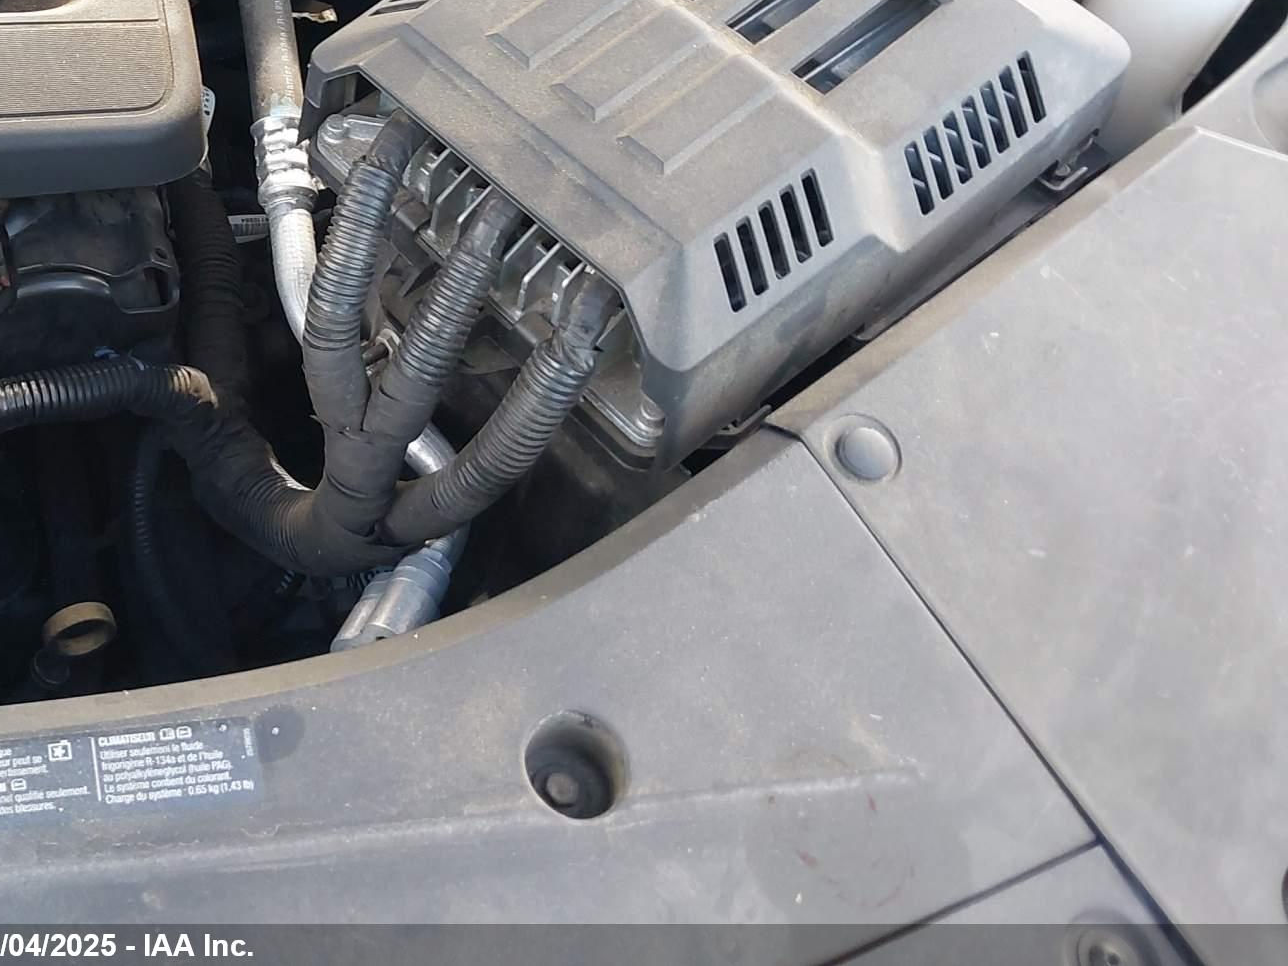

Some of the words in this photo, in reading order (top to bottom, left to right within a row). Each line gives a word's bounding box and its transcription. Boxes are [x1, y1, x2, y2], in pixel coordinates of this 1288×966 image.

[98, 731, 156, 747] CLIMATISEUR
[129, 744, 171, 757] seulement
[172, 743, 180, 752] le
[181, 740, 204, 751] fluide
[12, 756, 31, 767] peut
[32, 756, 42, 764] se
[146, 754, 177, 766] R-134a
[177, 754, 186, 762] et
[187, 752, 198, 761] de
[103, 774, 114, 783] au
[211, 759, 233, 771] PAG).
[104, 784, 115, 793] Le
[116, 780, 150, 793] système
[151, 776, 184, 788] contient
[185, 774, 196, 784] du
[197, 771, 232, 783] colorant.
[46, 786, 90, 798] seulement.
[105, 793, 135, 806] Charge
[136, 792, 146, 802] du
[148, 787, 182, 801] système
[208, 783, 219, 794] kg
[243, 779, 254, 790] lb)
[15, 801, 56, 813] blessures.
